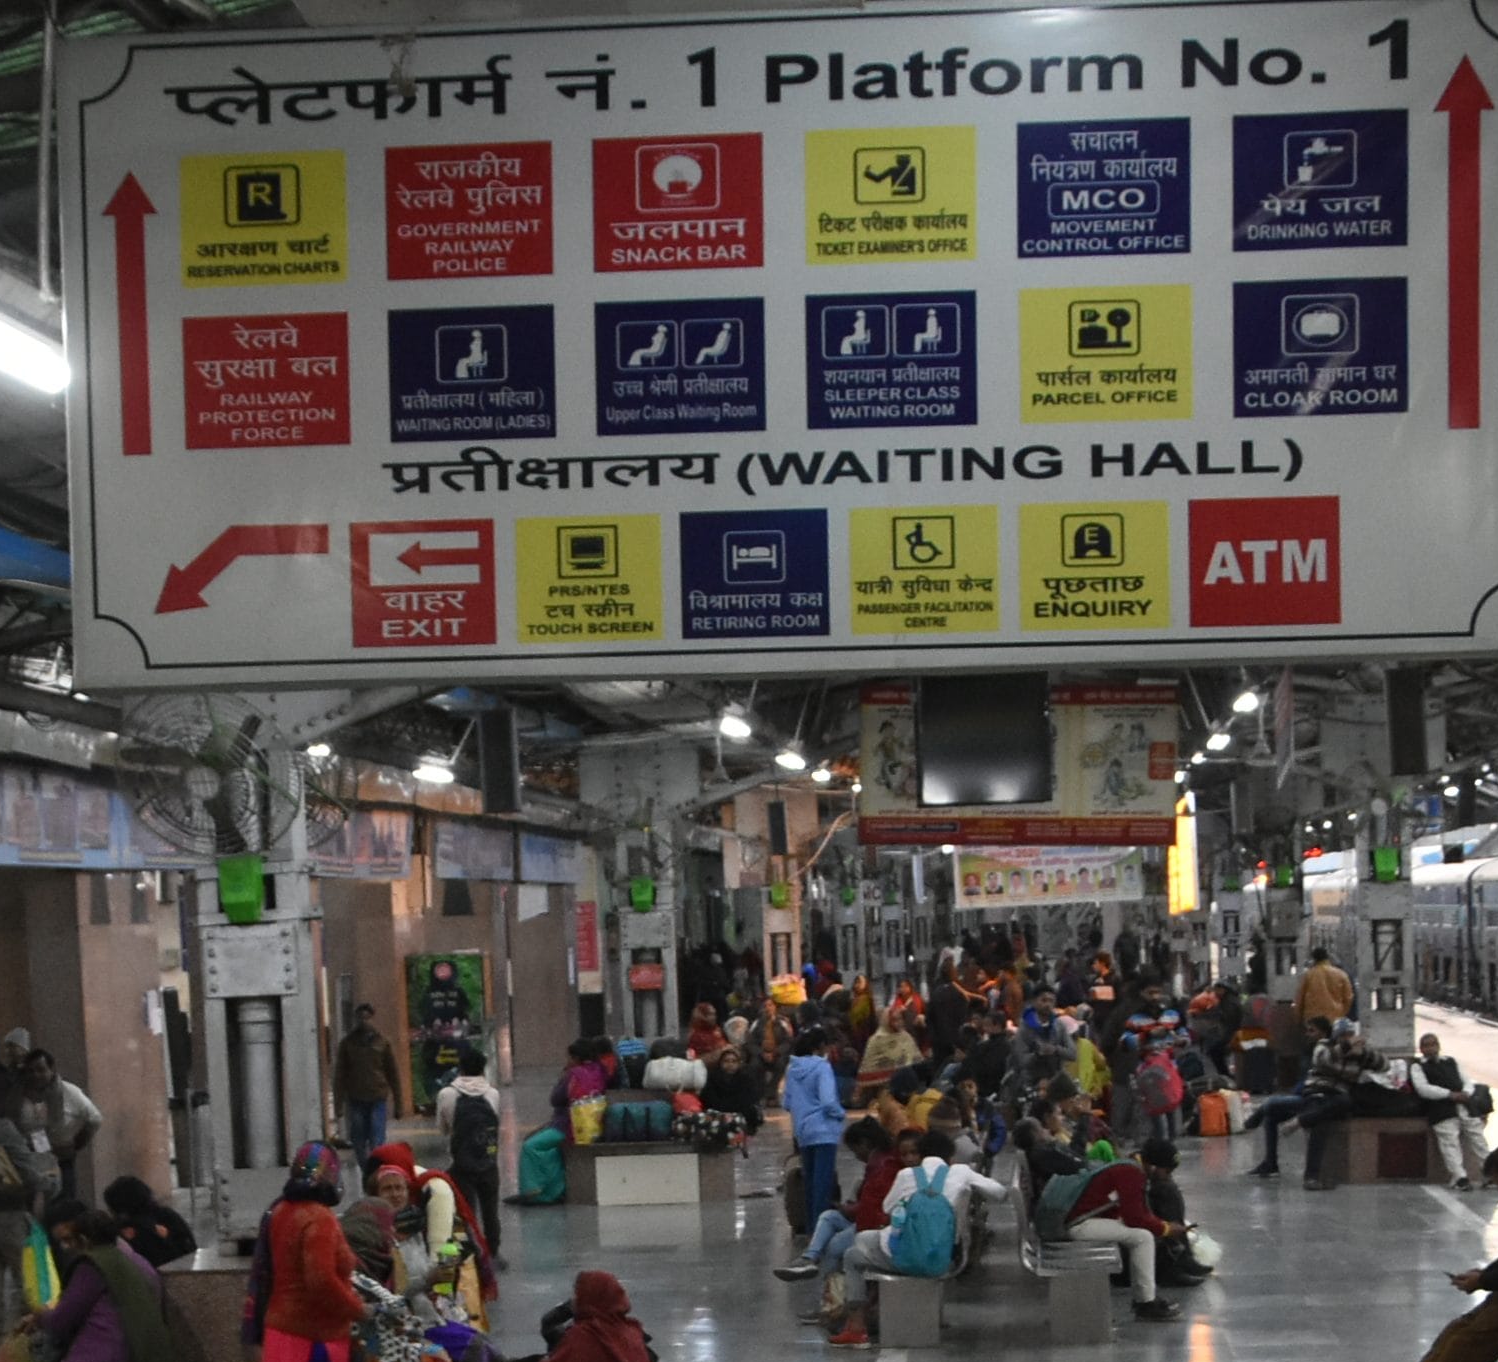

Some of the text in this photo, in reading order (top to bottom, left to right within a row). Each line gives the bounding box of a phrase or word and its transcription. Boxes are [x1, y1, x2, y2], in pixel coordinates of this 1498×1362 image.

[164, 18, 1411, 126] प्लेटफार्म नं. 1 Platform No. 1
[1069, 126, 1139, 152] संचालन
[415, 152, 522, 178] राजकीय
[1031, 150, 1177, 183] नियंत्रण कार्यालय
[248, 183, 272, 206] R
[395, 179, 542, 213] रेलवे पुलिस
[1062, 187, 1145, 210] MCO
[1261, 194, 1381, 216] पेय जल
[397, 219, 541, 237] GOVERNMENT
[610, 218, 746, 242] जलपान
[819, 208, 967, 232] टिकट परीक्षक कार्यालय
[1051, 218, 1157, 234] MOVEMENT
[1248, 220, 1392, 241] DRINKING WATER
[196, 234, 330, 259] आरक्षण चार्ट
[425, 239, 514, 255] RAILWAY
[611, 244, 747, 264] SNACK BAR
[816, 239, 967, 256] TICKET EXAMINER'S OFFICE
[1022, 234, 1185, 253] CONTROL OFFICE
[188, 260, 339, 278] RESERVATION CHARTS
[433, 257, 507, 273] POLICE
[232, 321, 299, 350] रेलवे
[193, 355, 338, 388] सुरक्षा बल
[824, 361, 961, 385] शयनयान प्रतीक्षालय
[1037, 362, 1177, 387] पार्सल कार्यालय
[1244, 363, 1310, 385] अमानती
[1373, 365, 1397, 382] घर
[649, 373, 679, 397] श्रेणी
[683, 372, 750, 396] प्रतीक्षालय
[824, 385, 961, 402] SLEEPER CLASS
[220, 391, 313, 407] RAILWAY
[400, 387, 475, 412] प्रतीक्षालय
[1032, 390, 1178, 406] PARCEL OFFICE
[1243, 388, 1398, 409] CLOAK ROOM
[200, 408, 336, 425] PROTECTION
[606, 403, 757, 424] Upper Class Waiting Room
[830, 403, 956, 419] WAITING ROOM
[232, 426, 304, 441] FORCE
[397, 413, 551, 433] WAITING ROOM (LADIES)
[382, 437, 1304, 496] प्रतीक्षालय (WAITING HALL)
[1204, 538, 1328, 586] ATM
[548, 584, 631, 598] PRS/NTES
[856, 573, 993, 601] यात्री सुविधा केन्द्र
[1043, 575, 1145, 601] पूछताछ
[381, 590, 467, 612] बाहर
[545, 602, 575, 619] टच
[688, 590, 823, 611] विश्रामालय कक्ष
[858, 600, 994, 615] PASSENGER FACILITATION
[1034, 600, 1153, 619] ENQUIRY
[382, 618, 467, 640] EXIT
[528, 621, 654, 636] TOUCH SCREEN
[692, 613, 821, 631] RETIRING ROOM
[904, 616, 947, 628] CENTRE
